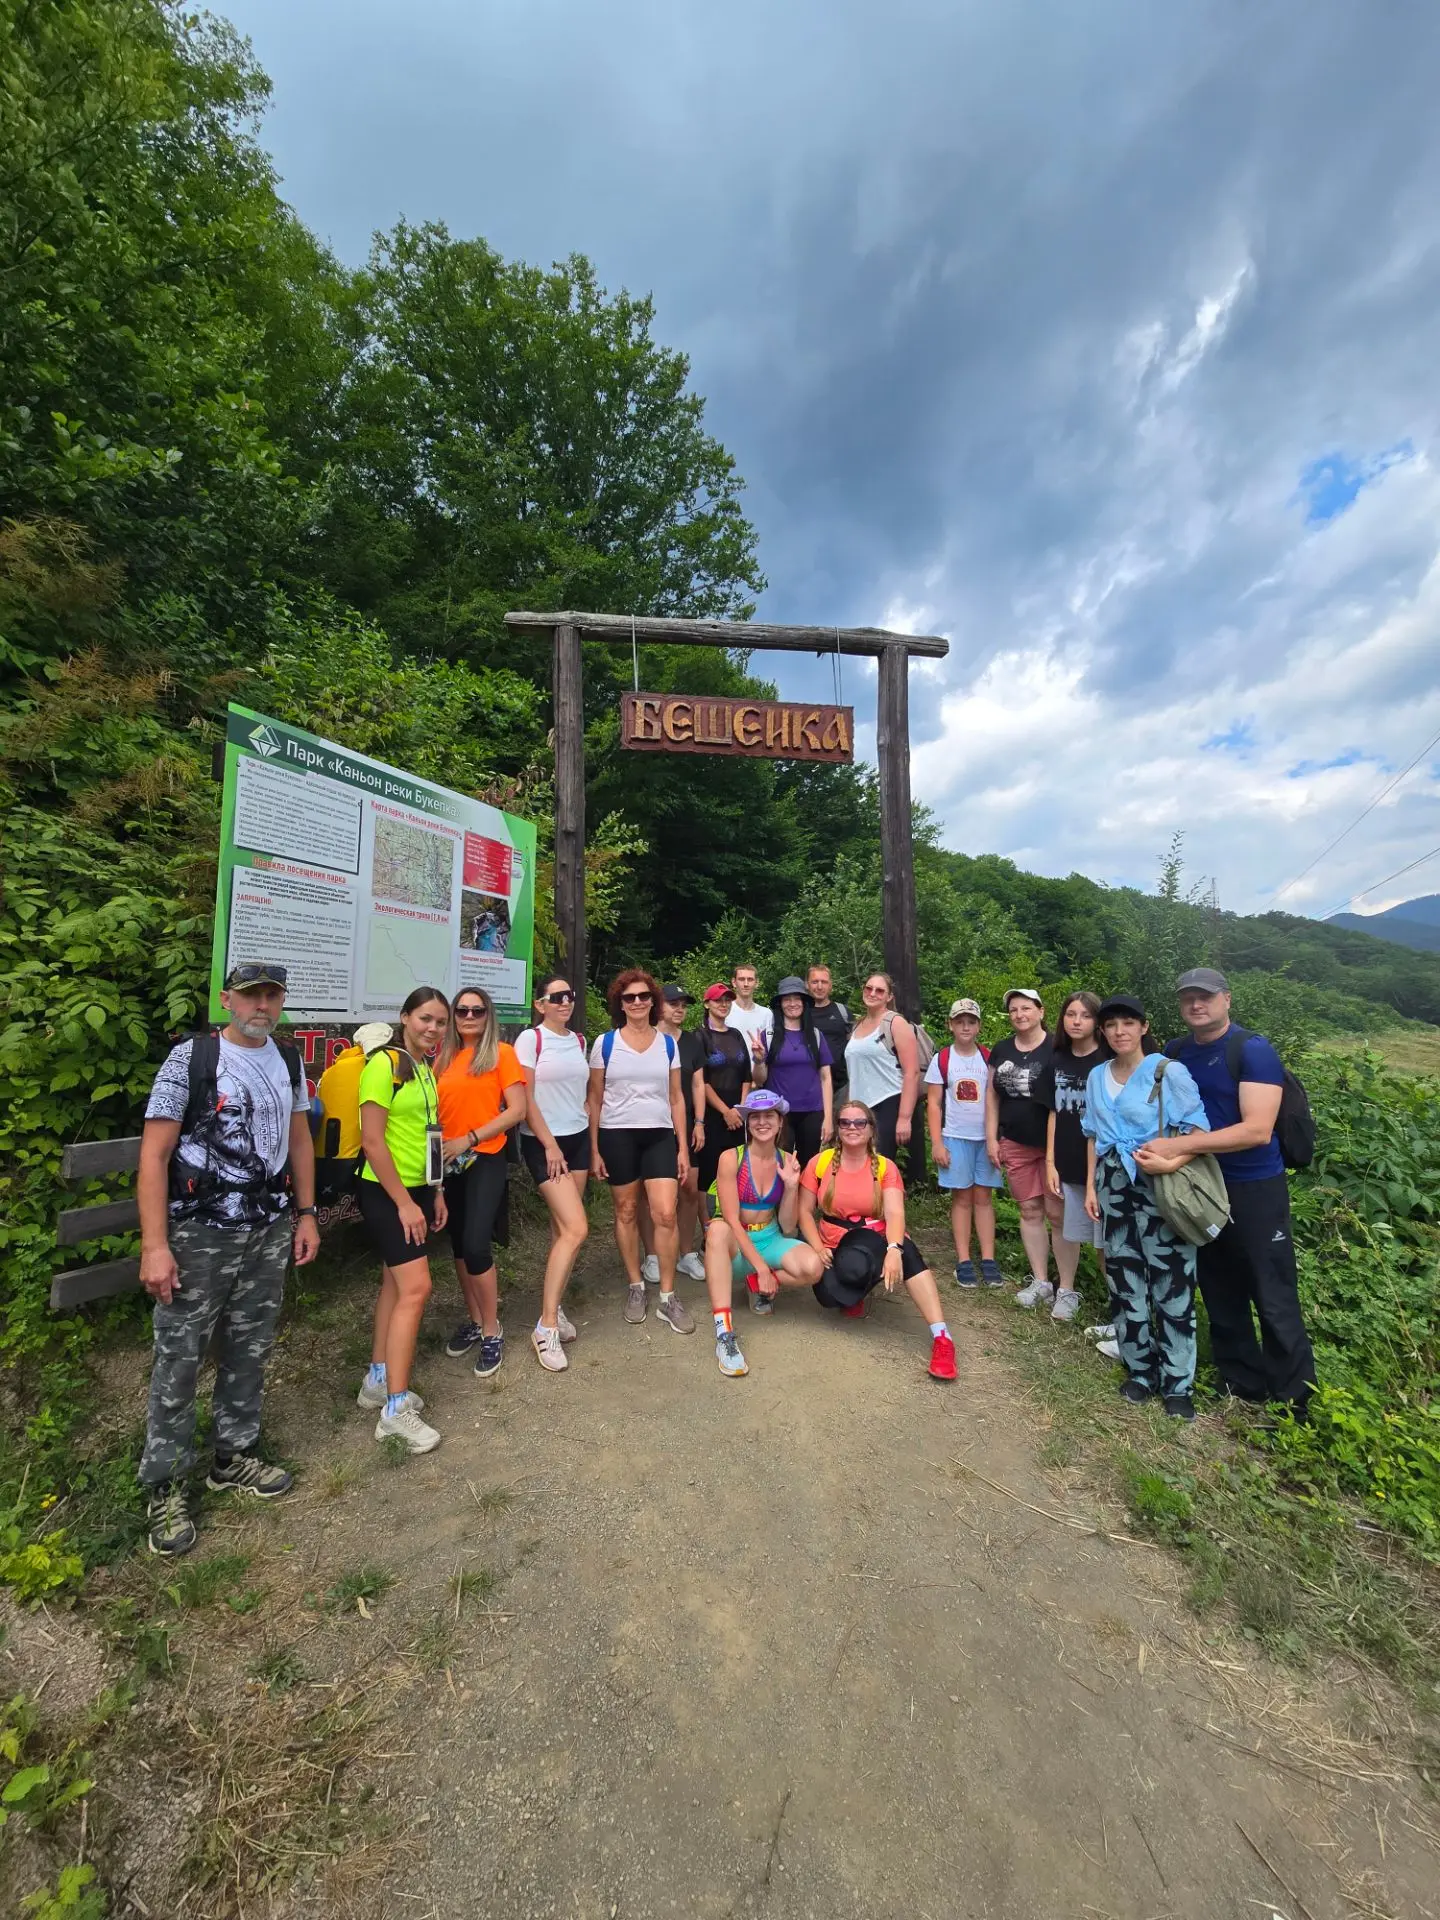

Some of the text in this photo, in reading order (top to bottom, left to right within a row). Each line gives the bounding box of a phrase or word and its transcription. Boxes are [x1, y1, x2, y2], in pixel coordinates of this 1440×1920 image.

[286, 739, 325, 768] Парк
[328, 758, 382, 789] «Каньон
[385, 780, 413, 800] реки
[371, 800, 388, 812] Карта
[253, 856, 347, 884] Правила посещения парка
[374, 902, 416, 917] Экологическая
